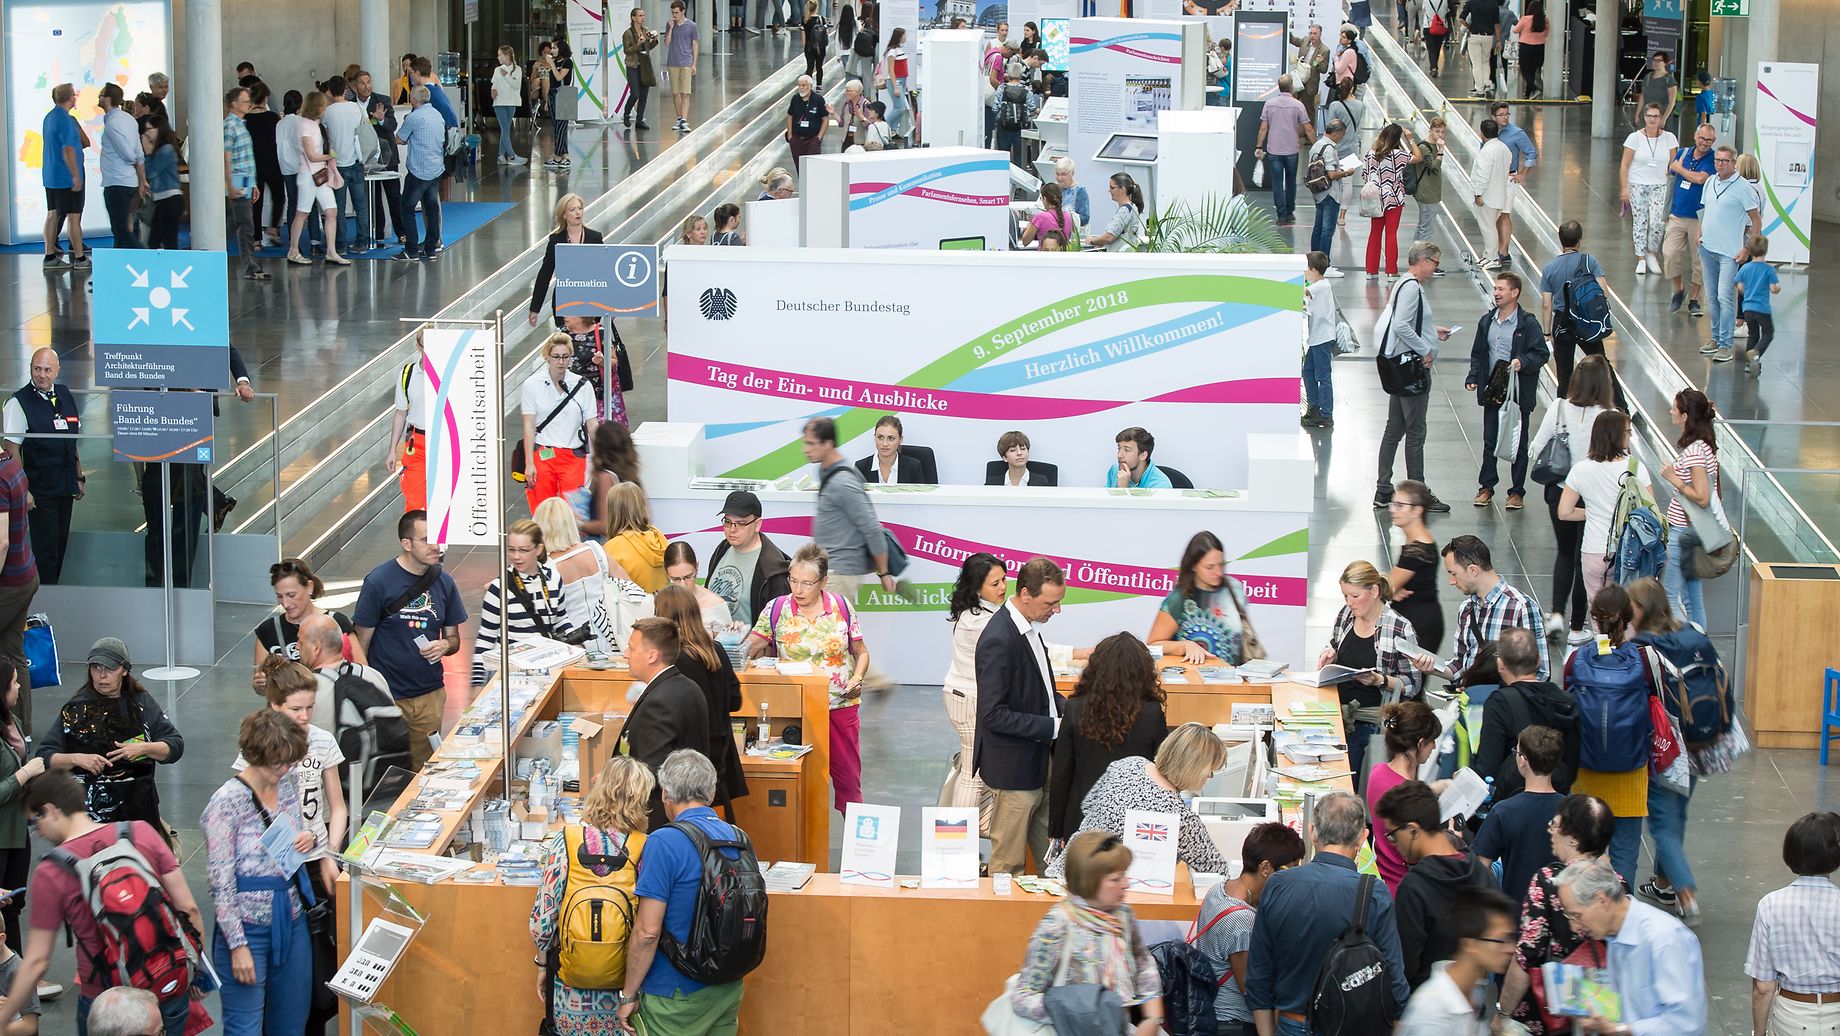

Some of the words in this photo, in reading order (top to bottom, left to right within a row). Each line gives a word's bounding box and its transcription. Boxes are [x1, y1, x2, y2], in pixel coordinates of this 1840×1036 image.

[868, 193, 886, 204] Presse
[887, 187, 898, 197] und
[899, 171, 942, 191] Kommunikation
[921, 189, 979, 205] Parlamentsfernsehen,
[979, 196, 996, 205] Smart
[996, 197, 1005, 205] TV
[556, 278, 608, 288] Information
[776, 299, 841, 312] Deutscher
[844, 300, 911, 315] Bundestag
[972, 345, 991, 359] 9.
[991, 303, 1081, 350] September
[1086, 290, 1129, 313] 2018
[1025, 348, 1100, 380] Herzlich
[1104, 311, 1225, 358] Willkommen!
[104, 352, 142, 361] Treffpunkt
[104, 361, 175, 372] Architekturführung
[105, 371, 123, 379] Band
[139, 372, 165, 380] Bundes
[707, 365, 738, 388] Tag
[742, 371, 772, 391] der
[777, 376, 813, 396] Ein-
[818, 385, 853, 402] und
[857, 387, 948, 411] Ausblicke
[116, 403, 155, 415] Führung
[144, 416, 159, 425] des
[469, 347, 488, 537] Öffentlichkeitsarbeit
[303, 787, 318, 820] 5
